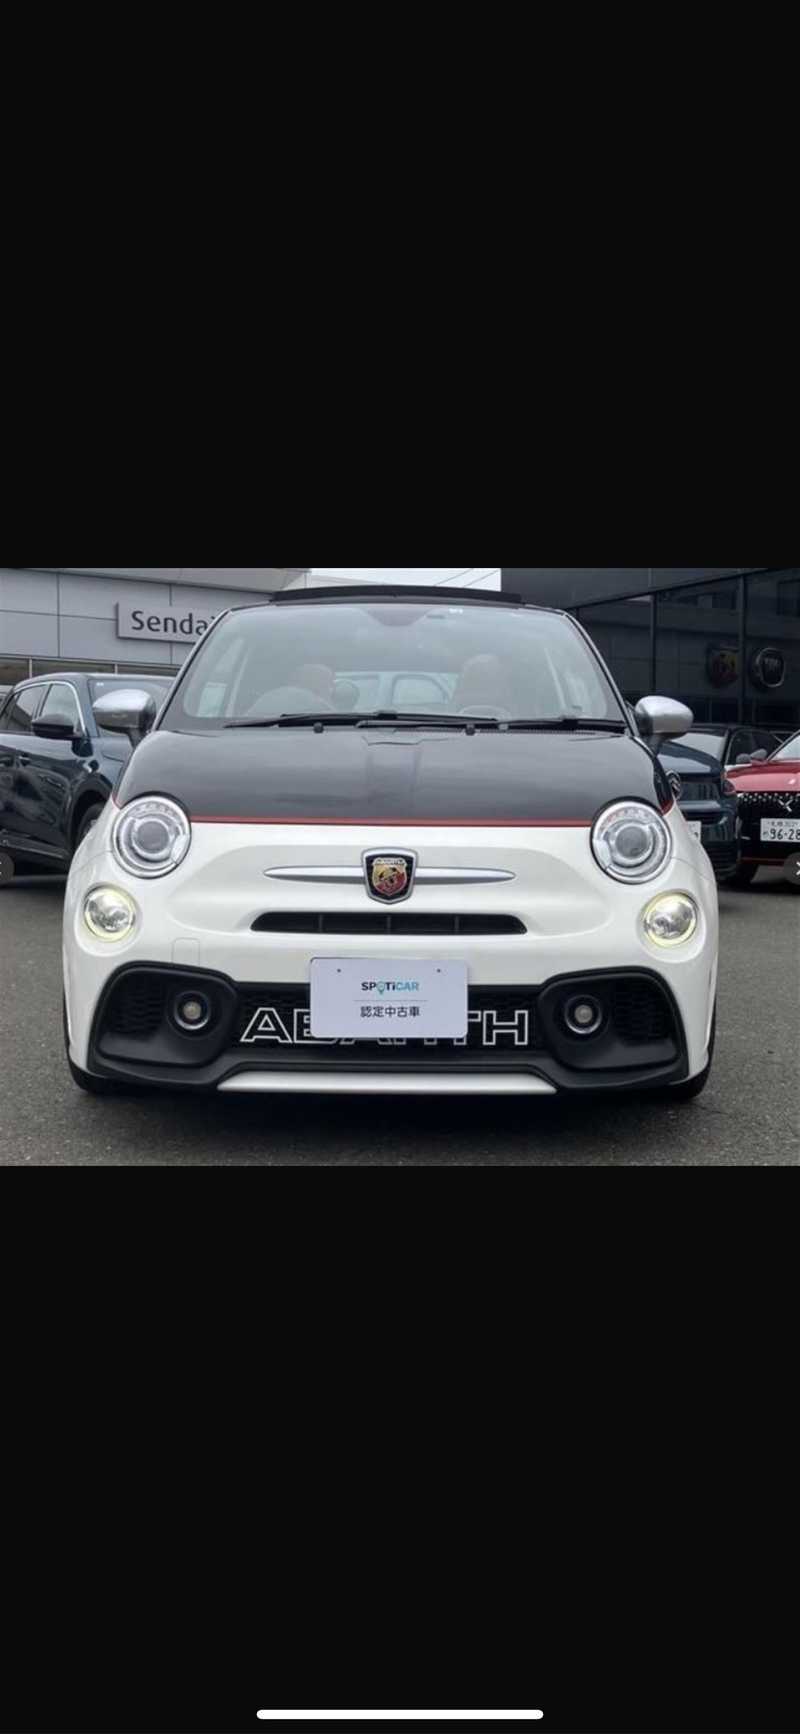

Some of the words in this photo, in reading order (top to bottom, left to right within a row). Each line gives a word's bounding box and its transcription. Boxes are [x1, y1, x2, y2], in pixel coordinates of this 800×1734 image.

[131, 610, 214, 636] Senda
[360, 1005, 420, 1018] 認定中古車
